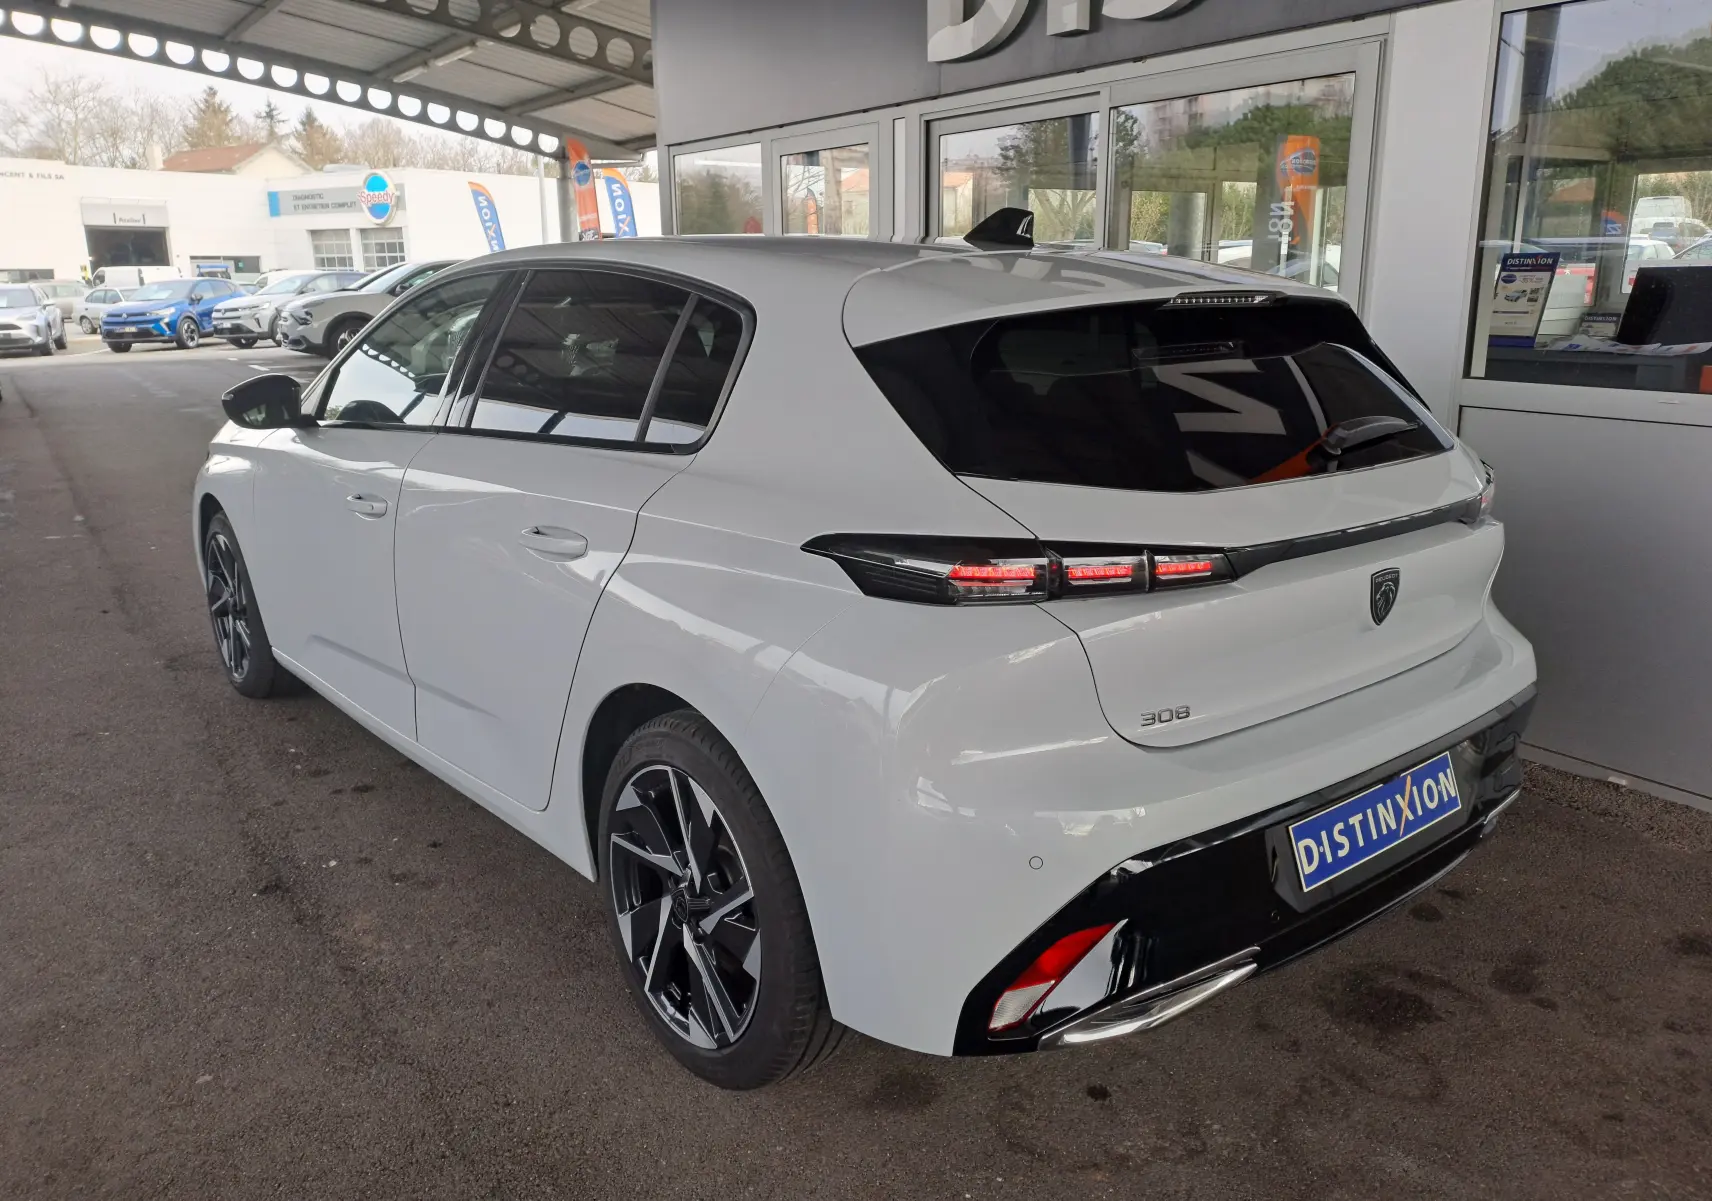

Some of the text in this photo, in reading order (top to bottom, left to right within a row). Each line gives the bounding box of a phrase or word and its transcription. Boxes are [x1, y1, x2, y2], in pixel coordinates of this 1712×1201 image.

[360, 189, 396, 205] Speedy
[1506, 256, 1554, 266] DISTINXION
[1140, 704, 1192, 728] 308
[1297, 767, 1457, 876] DISTINXION
